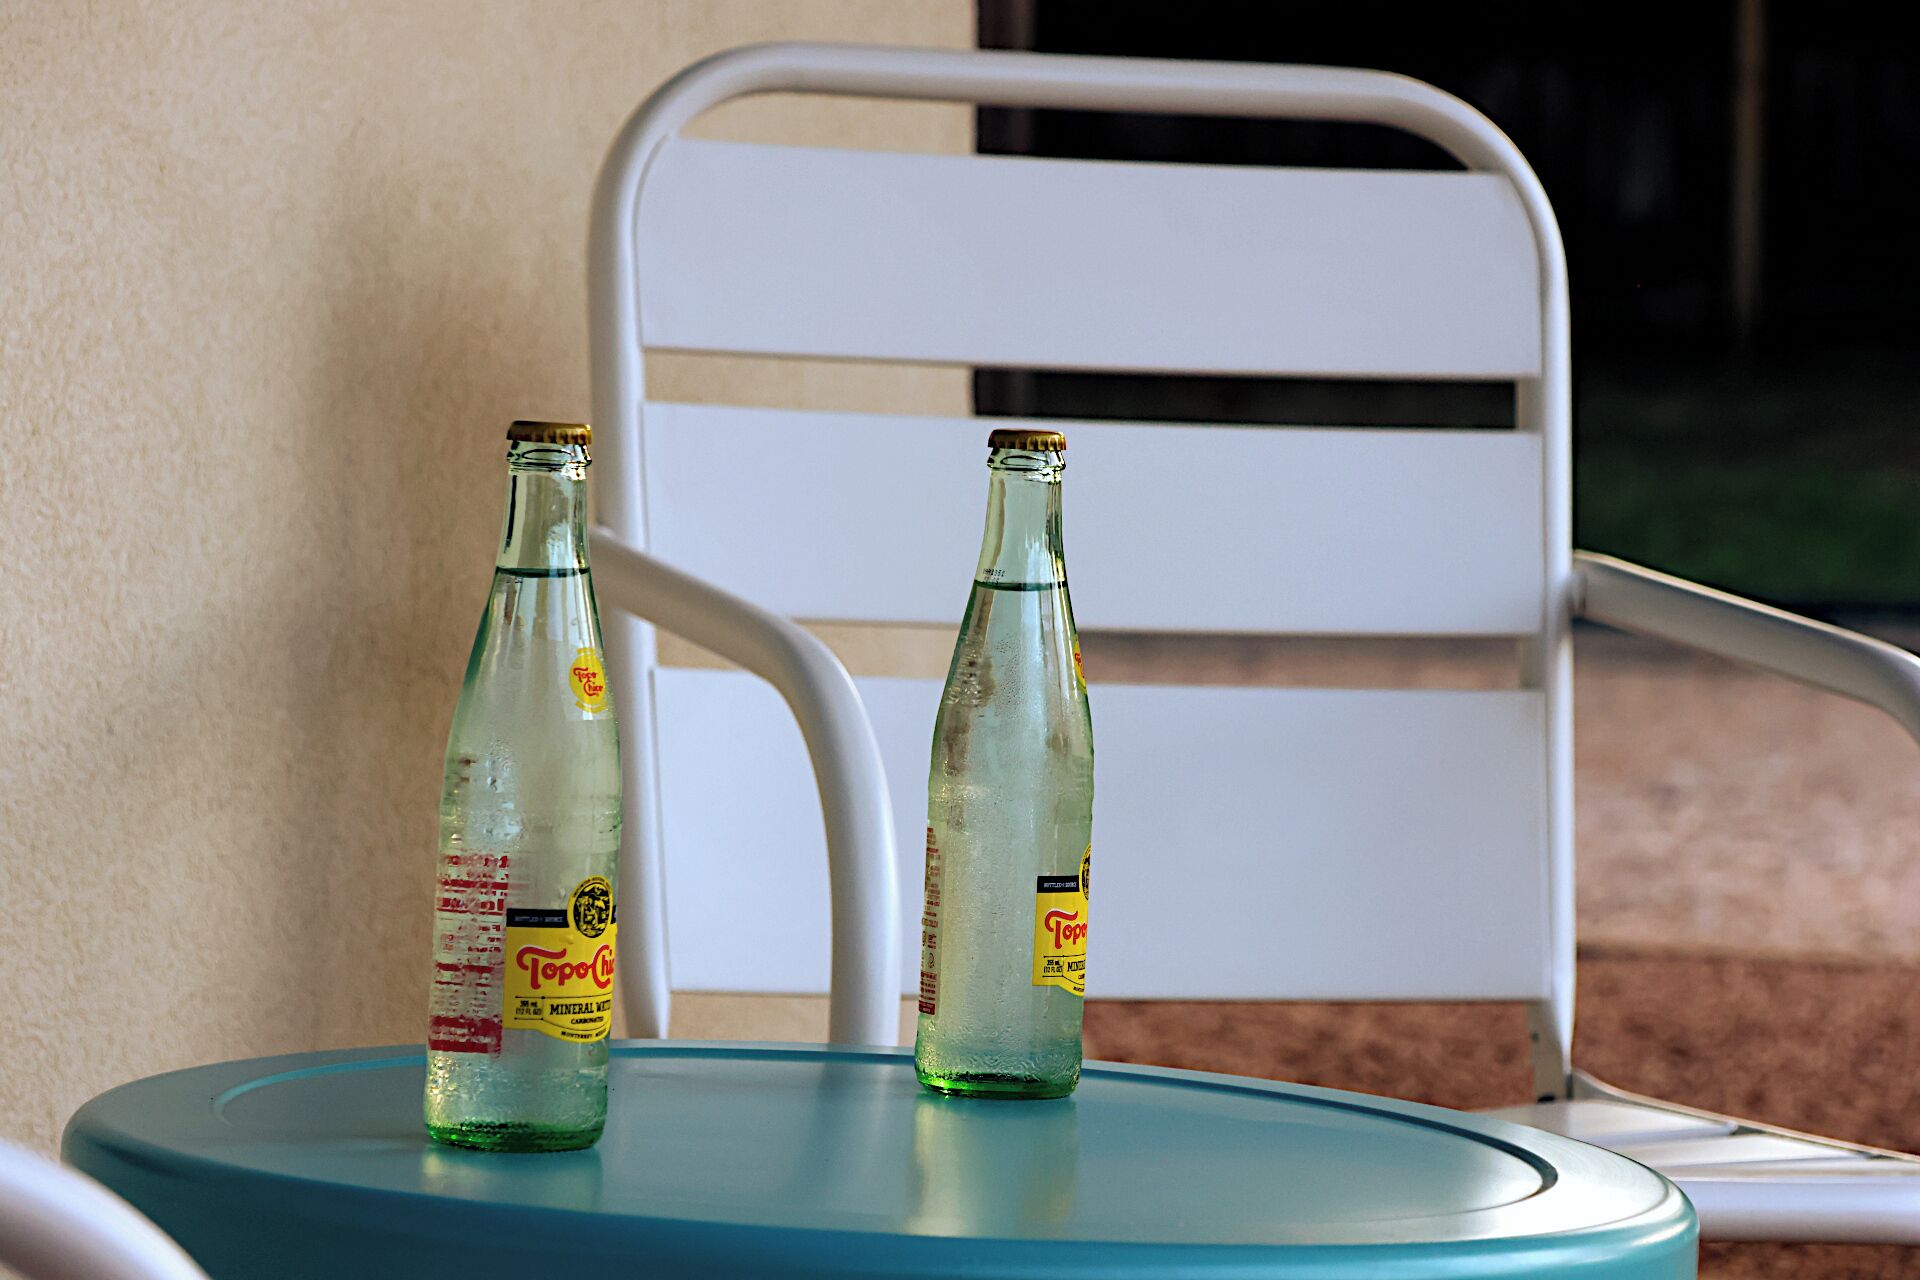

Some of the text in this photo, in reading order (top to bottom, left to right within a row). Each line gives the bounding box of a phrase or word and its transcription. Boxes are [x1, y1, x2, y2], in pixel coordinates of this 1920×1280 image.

[573, 667, 597, 683] Topo
[1044, 910, 1087, 949] Topo
[516, 946, 589, 990] Topo
[549, 1002, 594, 1016] MINERAL
